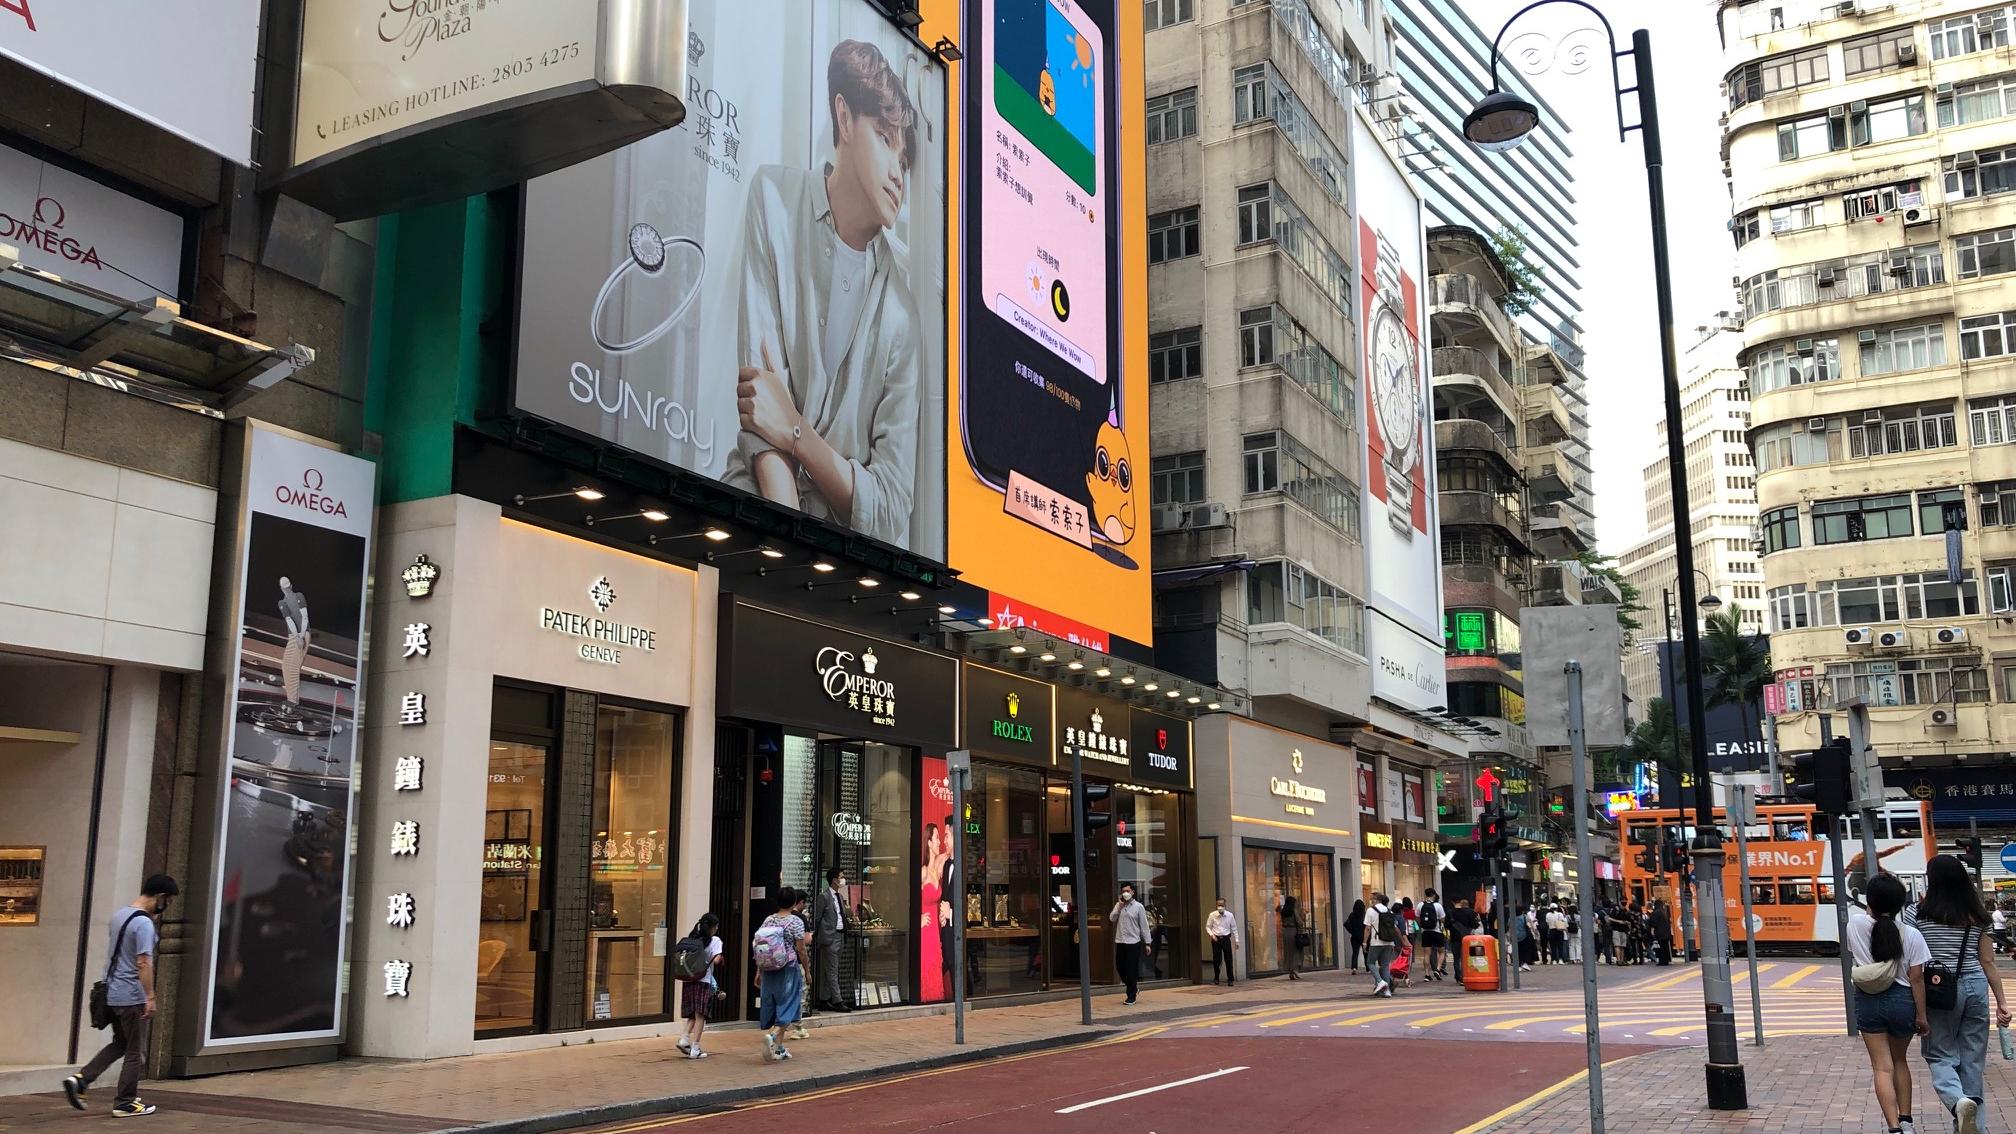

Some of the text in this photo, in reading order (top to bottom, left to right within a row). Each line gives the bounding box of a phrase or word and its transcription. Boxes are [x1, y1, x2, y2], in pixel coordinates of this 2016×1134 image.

[402, 16, 471, 61] Plaza
[333, 42, 580, 135] LEASING HOTLINE: 2803 4275
[694, 145, 741, 182] since 1942
[0, 213, 102, 271] OMEGA
[1013, 310, 1082, 364] Creator: Where We Wow
[276, 485, 347, 519] OMEGA
[1014, 486, 1084, 534] 首席講師 索索子
[543, 607, 656, 650] PATEK PHILIPPE
[580, 643, 622, 664] GENEVE
[816, 646, 895, 701] EMPEROR
[1381, 656, 1406, 680] PASHA
[1415, 662, 1440, 696] Cartier
[848, 691, 895, 717] 英皇珠寶
[992, 719, 1033, 743] ROLEX
[1148, 752, 1178, 771] TUDOR
[384, 622, 431, 997] 英皇鐘錶珠寶
[1944, 783, 2014, 798] 香港賽馬
